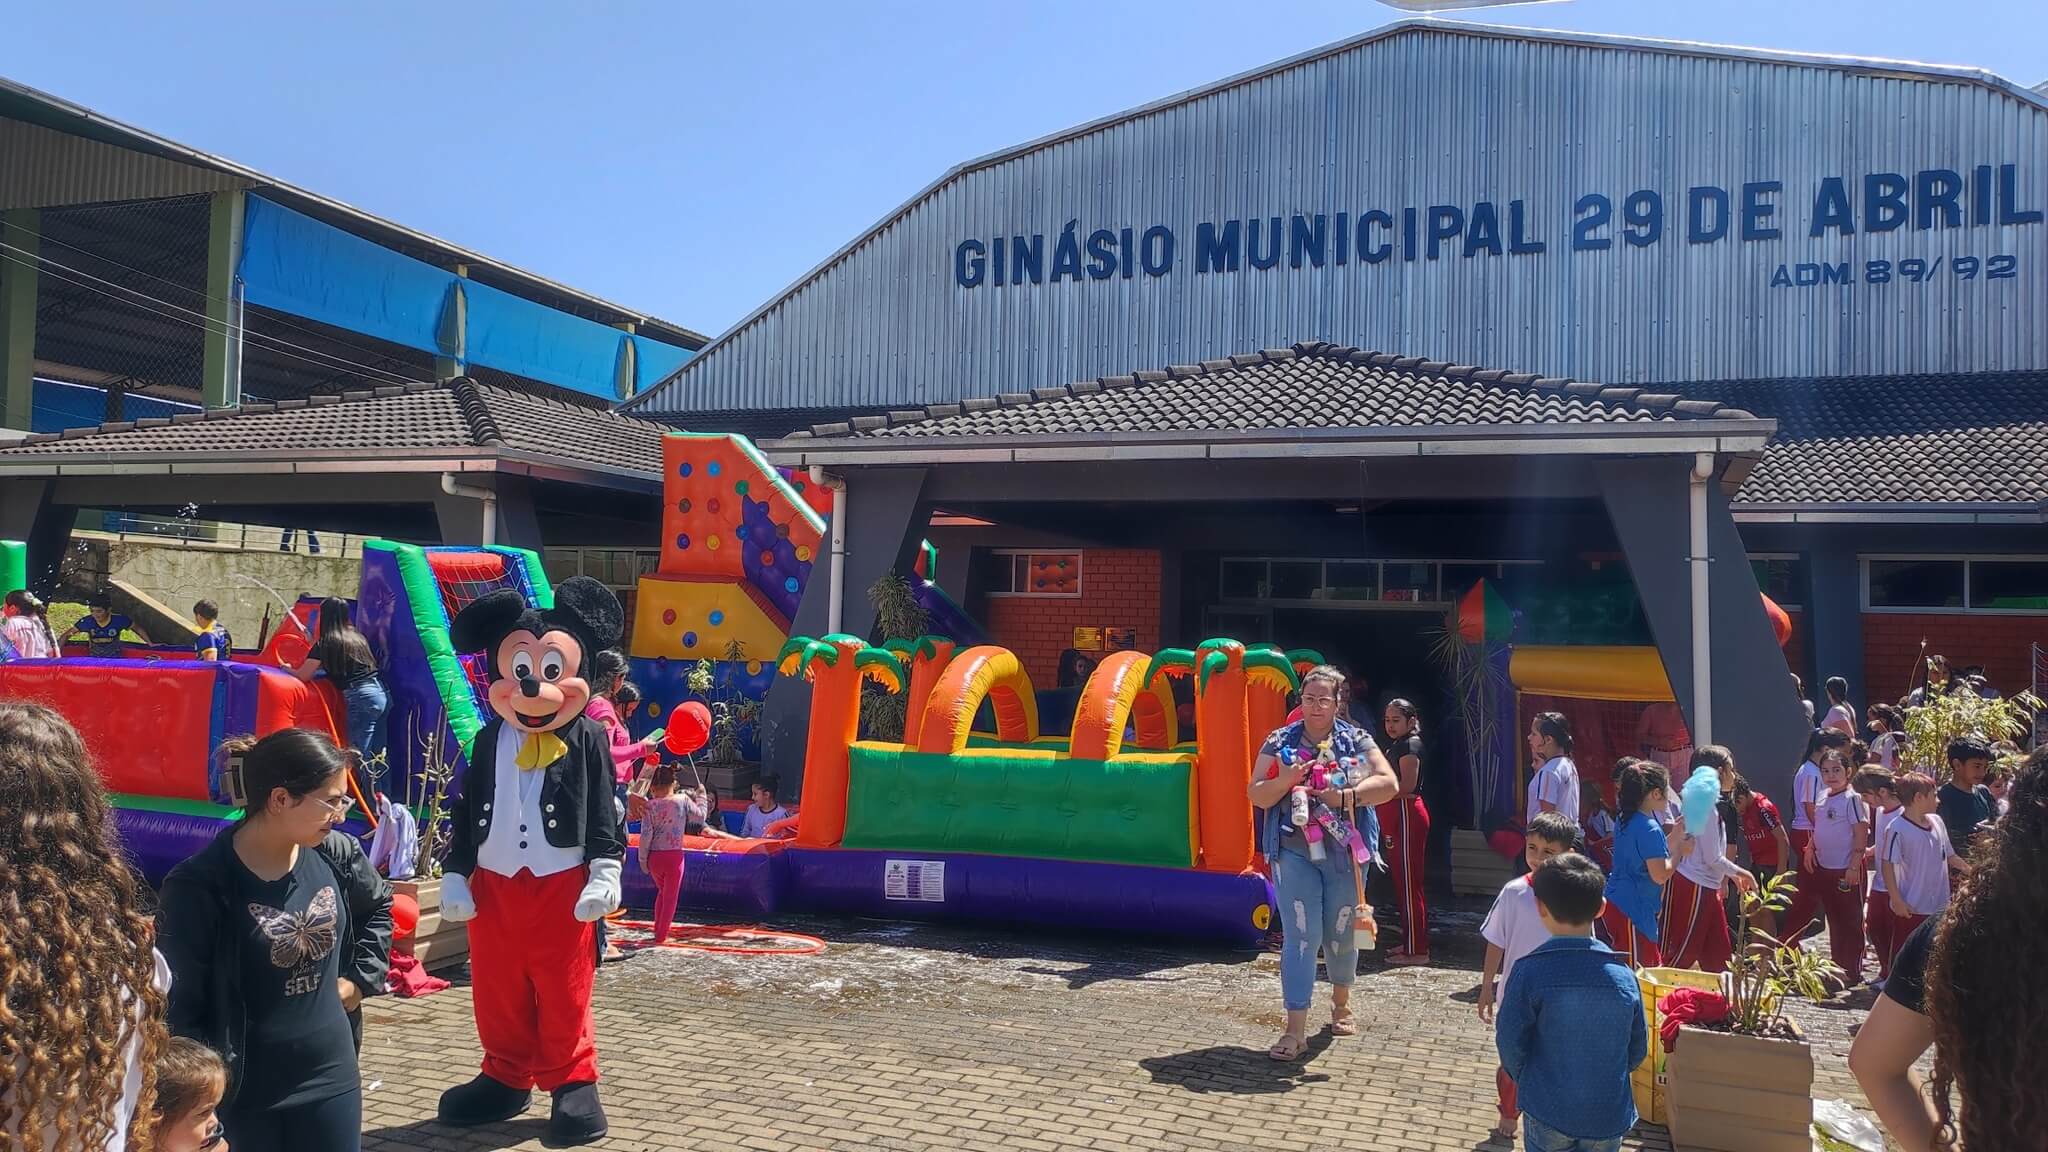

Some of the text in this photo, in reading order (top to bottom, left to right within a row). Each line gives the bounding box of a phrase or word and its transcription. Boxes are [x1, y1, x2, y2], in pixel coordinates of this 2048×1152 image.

[956, 164, 2044, 288] GINÁSIO MUNICIPAL 29 DE ABRIL
[1770, 262, 1856, 288] ADM.
[284, 972, 321, 996] SELF
